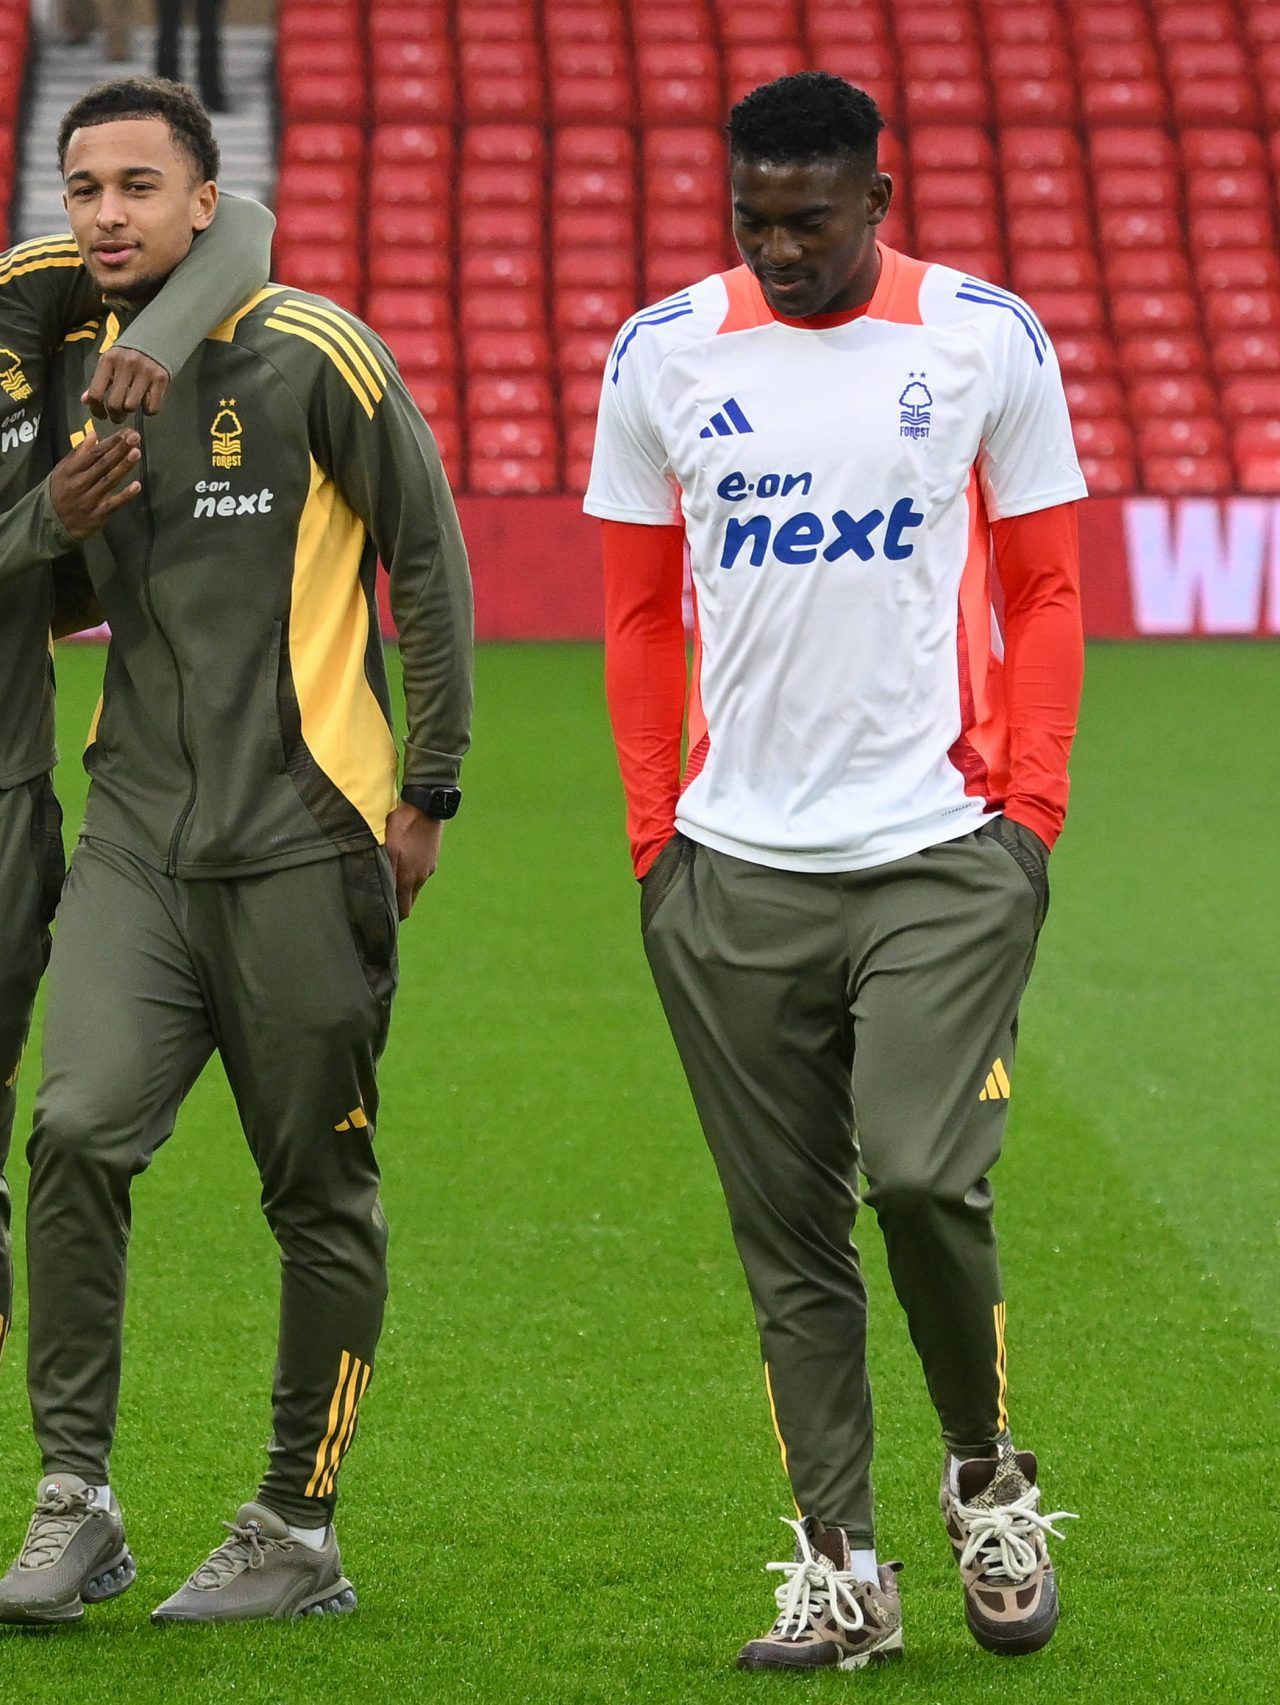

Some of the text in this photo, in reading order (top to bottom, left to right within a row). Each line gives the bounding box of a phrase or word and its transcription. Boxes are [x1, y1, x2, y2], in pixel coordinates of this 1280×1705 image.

[1, 407, 43, 453] nex
[193, 488, 274, 518] next
[720, 497, 924, 569] next
